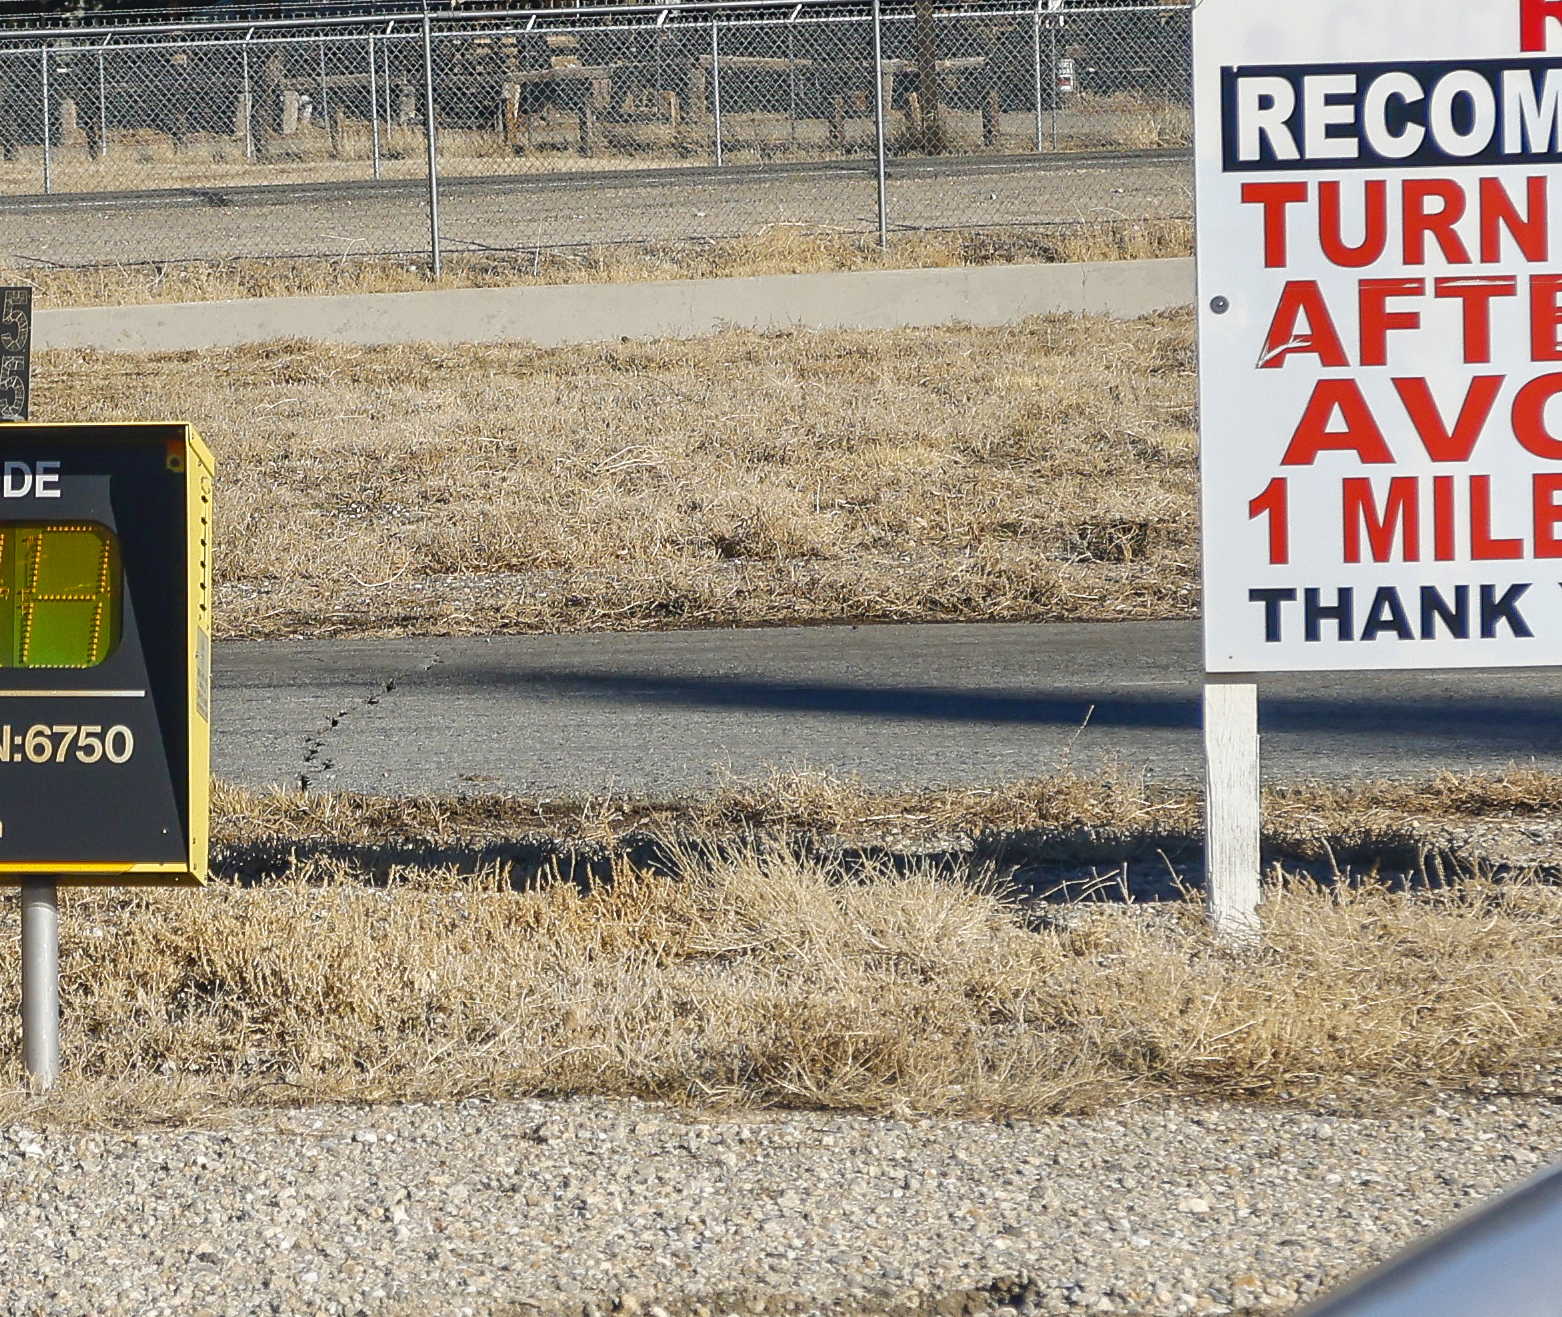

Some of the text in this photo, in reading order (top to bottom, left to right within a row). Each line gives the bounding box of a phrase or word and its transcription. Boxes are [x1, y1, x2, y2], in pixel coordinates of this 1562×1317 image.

[1242, 176, 1548, 269] TURN
[1249, 478, 1288, 565] 1
[1248, 583, 1534, 643] THANK
